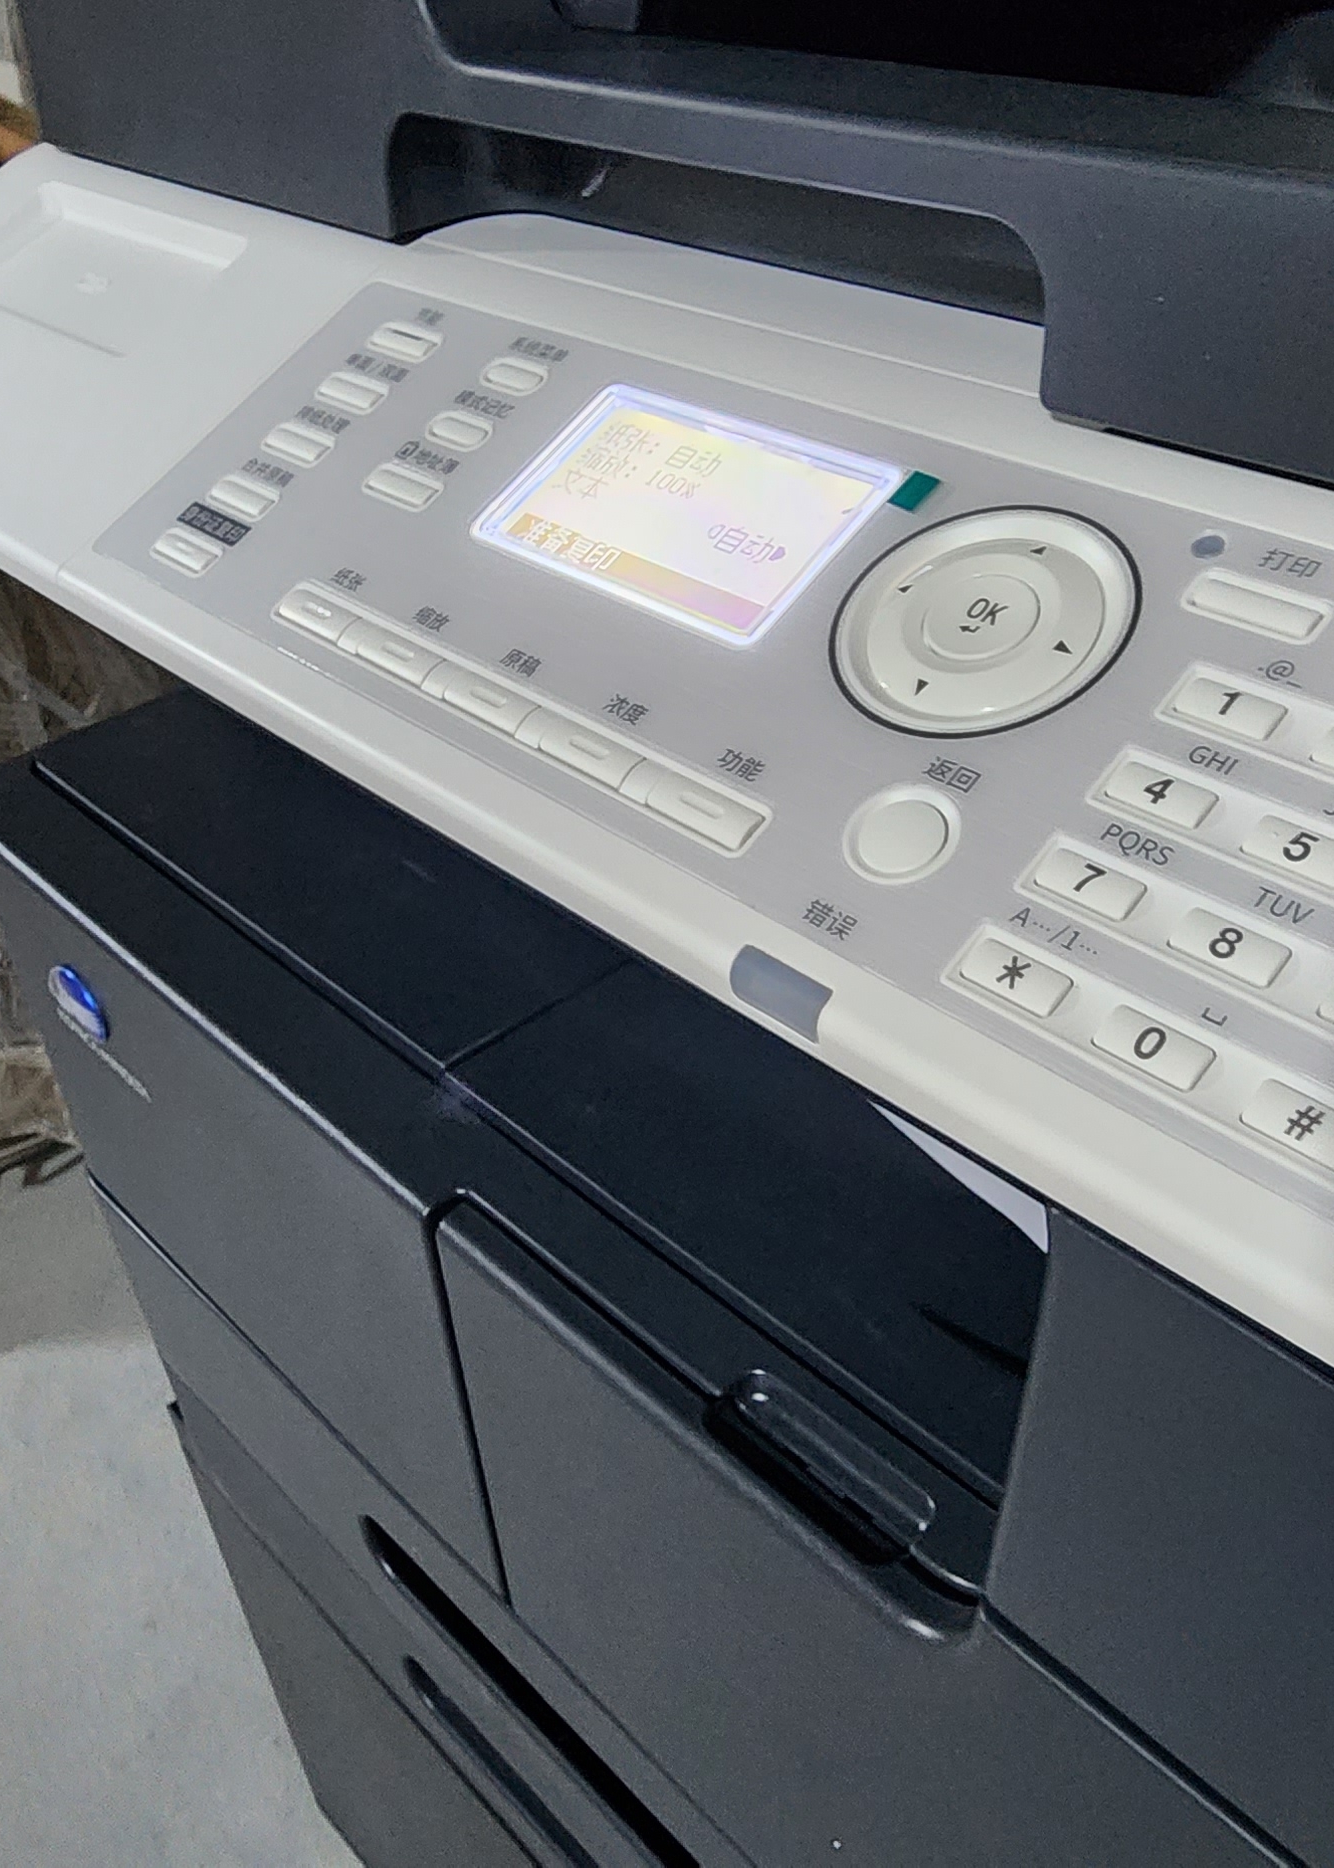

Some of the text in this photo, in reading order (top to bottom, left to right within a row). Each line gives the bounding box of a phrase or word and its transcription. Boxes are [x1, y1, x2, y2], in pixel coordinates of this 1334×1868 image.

[665, 445, 722, 477] 自动
[552, 469, 610, 500] 文本
[645, 470, 702, 500] 100%
[523, 518, 622, 572] 准备复印
[713, 527, 775, 564] 自动
[1259, 548, 1322, 578] 打印
[330, 566, 367, 593] 纸张
[410, 605, 451, 634] 缩放
[966, 598, 1010, 627] OK
[499, 648, 542, 678] 原稿
[601, 691, 650, 727] 浓度
[1217, 691, 1241, 715] 1
[715, 747, 766, 783] 功能
[920, 755, 982, 794] 返回
[1187, 745, 1239, 775] GHI
[1144, 778, 1174, 804] 4
[1101, 823, 1176, 866] PQRS
[1282, 831, 1319, 863] 5
[1071, 863, 1105, 894] 7
[801, 899, 859, 942] 错误
[1253, 886, 1315, 925] TUV
[1208, 928, 1244, 959] 8
[1133, 1026, 1167, 1061] 0
[1283, 1105, 1326, 1141] #
